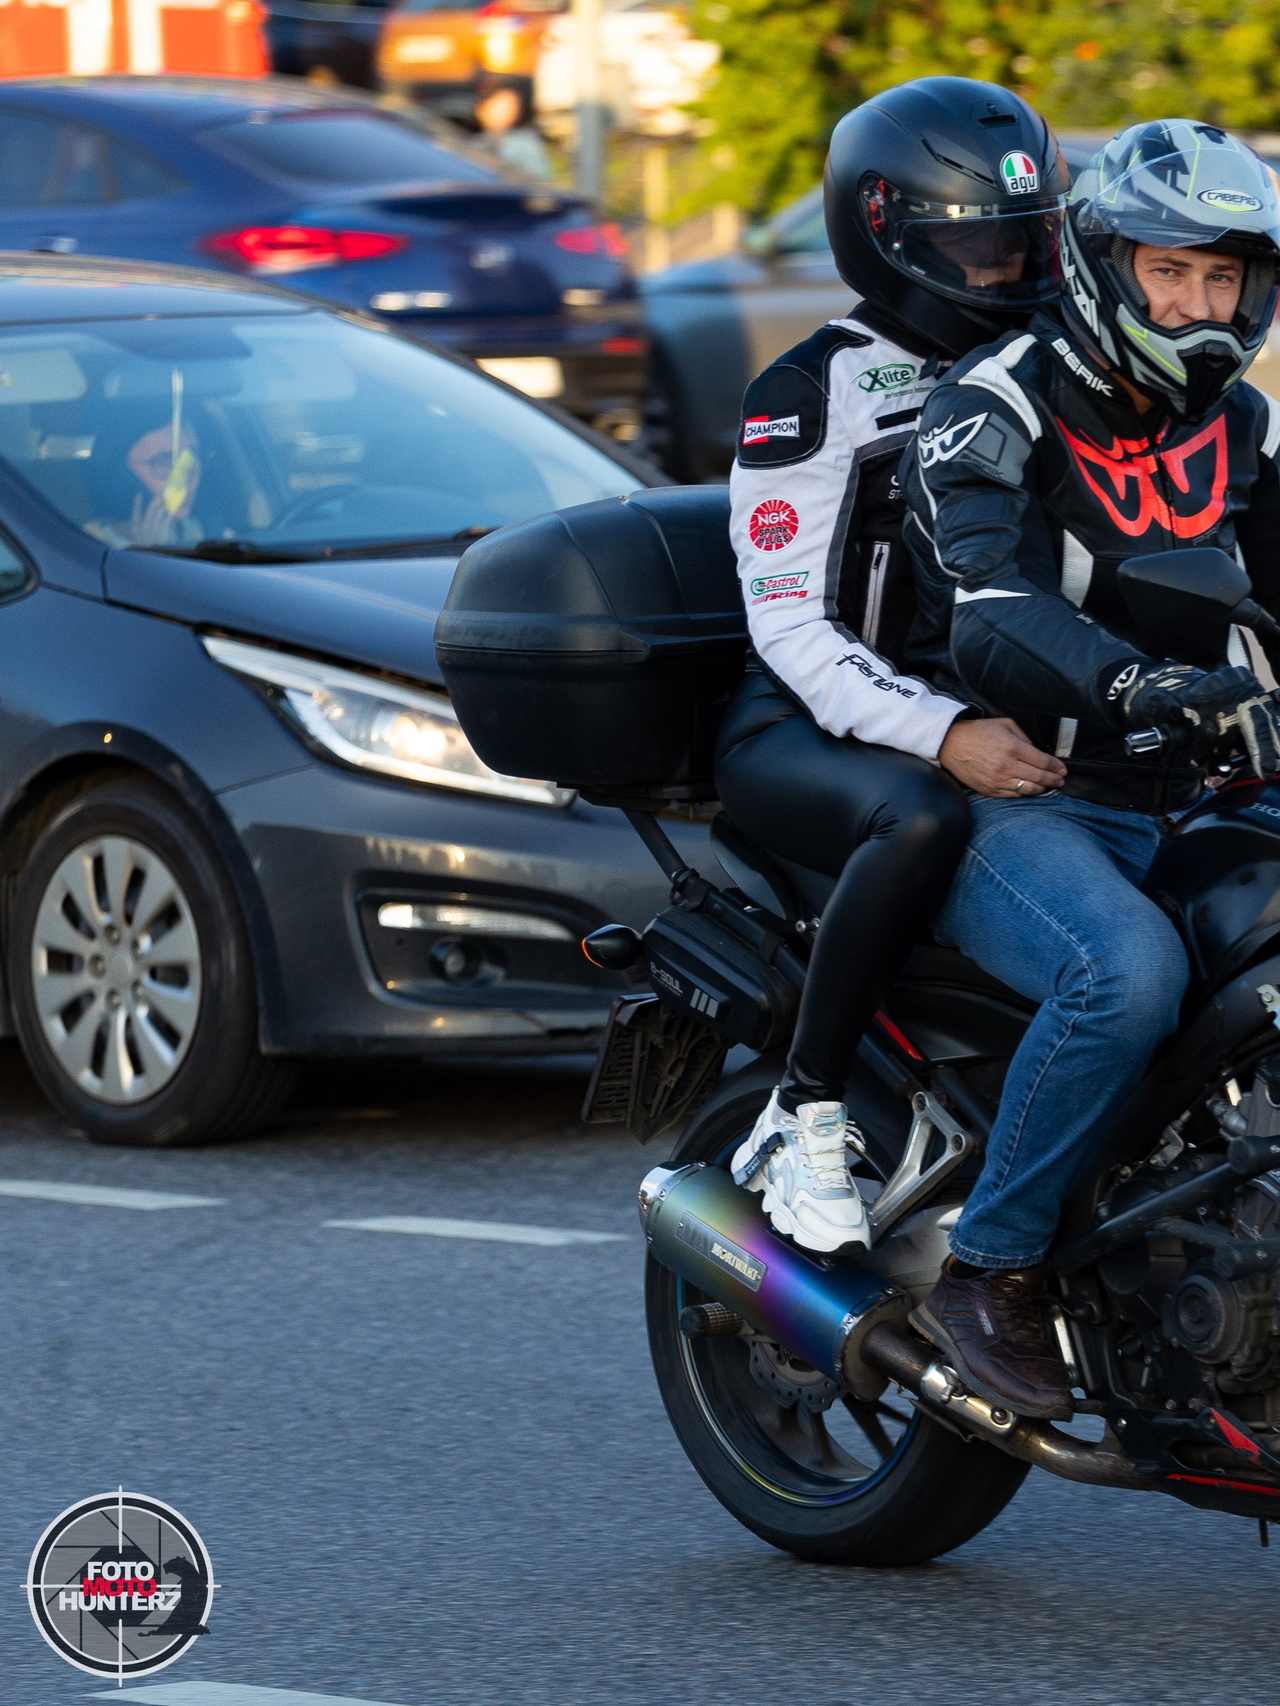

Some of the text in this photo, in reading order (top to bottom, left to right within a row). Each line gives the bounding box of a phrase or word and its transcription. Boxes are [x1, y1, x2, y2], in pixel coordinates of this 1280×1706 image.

[1051, 337, 1114, 397] BERIK
[865, 369, 911, 392] X-lite
[746, 421, 798, 438] CHAMPION
[757, 510, 790, 526] NGK
[758, 526, 789, 537] SPARK
[758, 535, 789, 546] PLUGS
[766, 575, 800, 590] Castrol
[763, 590, 808, 602] racing
